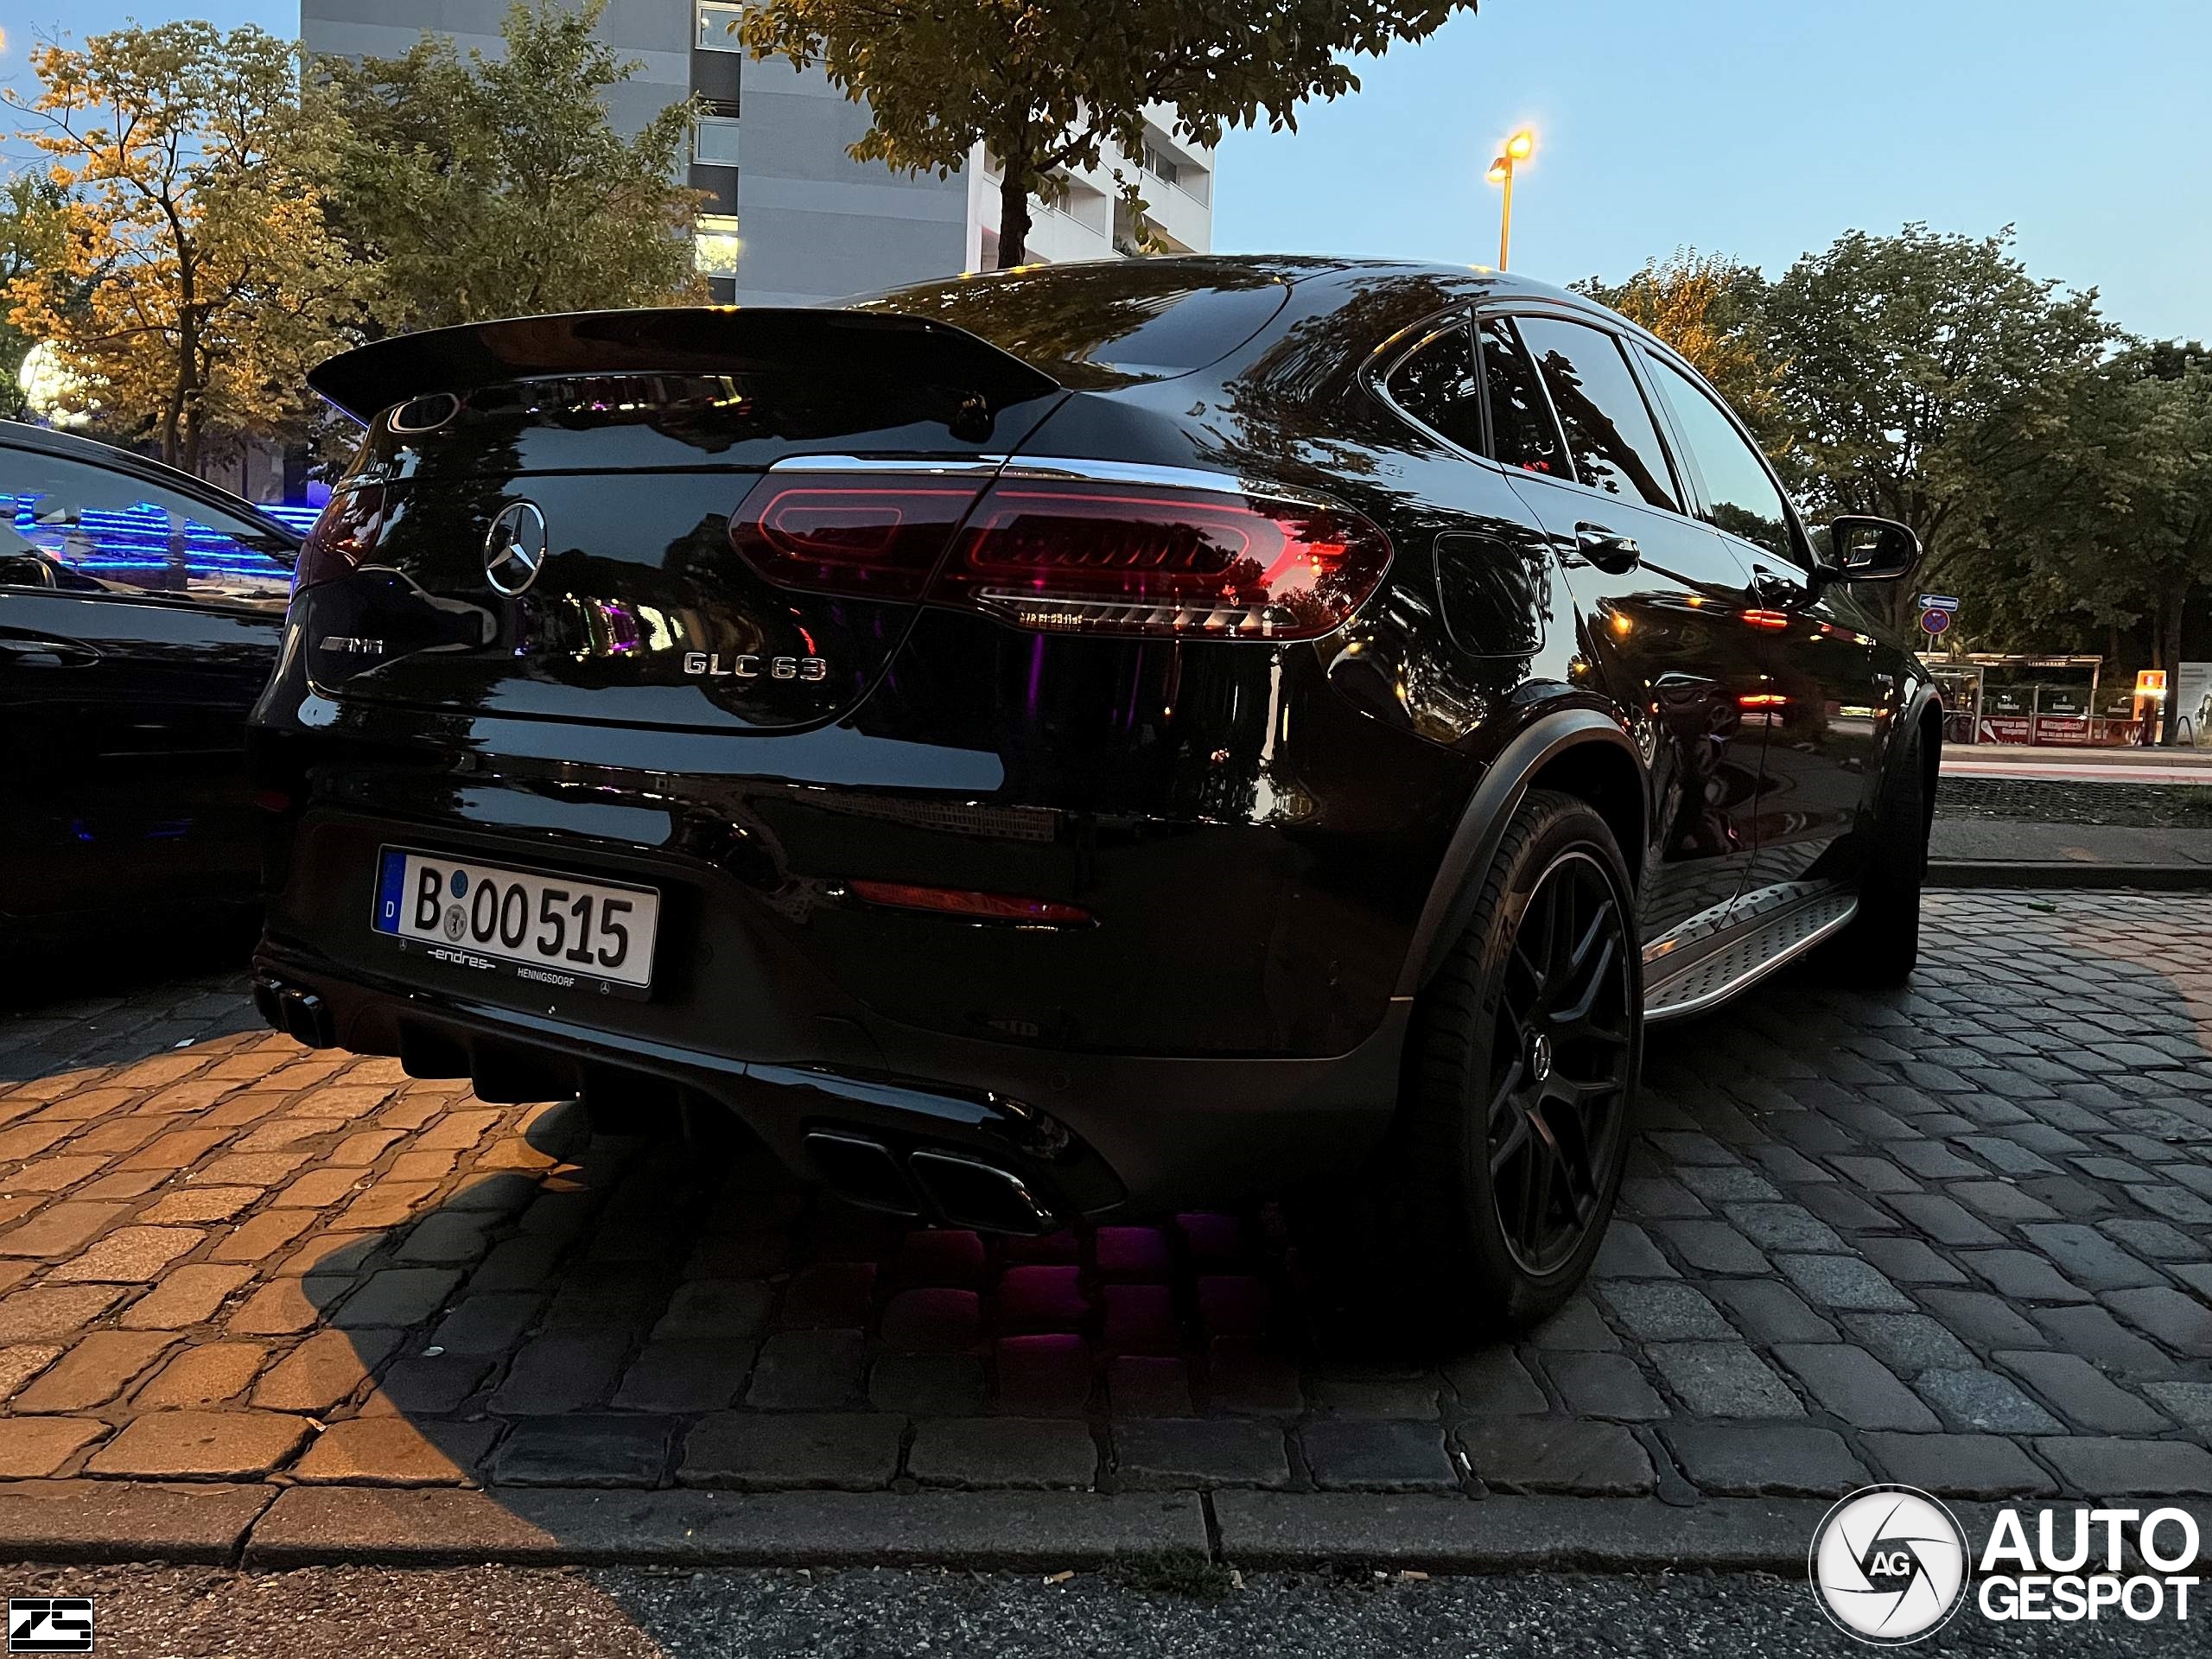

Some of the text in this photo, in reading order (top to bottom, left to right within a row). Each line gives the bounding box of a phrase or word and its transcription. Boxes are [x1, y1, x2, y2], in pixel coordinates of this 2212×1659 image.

[683, 652, 827, 681] GLC 63
[385, 900, 395, 918] D
[415, 867, 442, 931] B
[434, 949, 490, 969] endres
[517, 967, 575, 988] HENNIGSDORF
